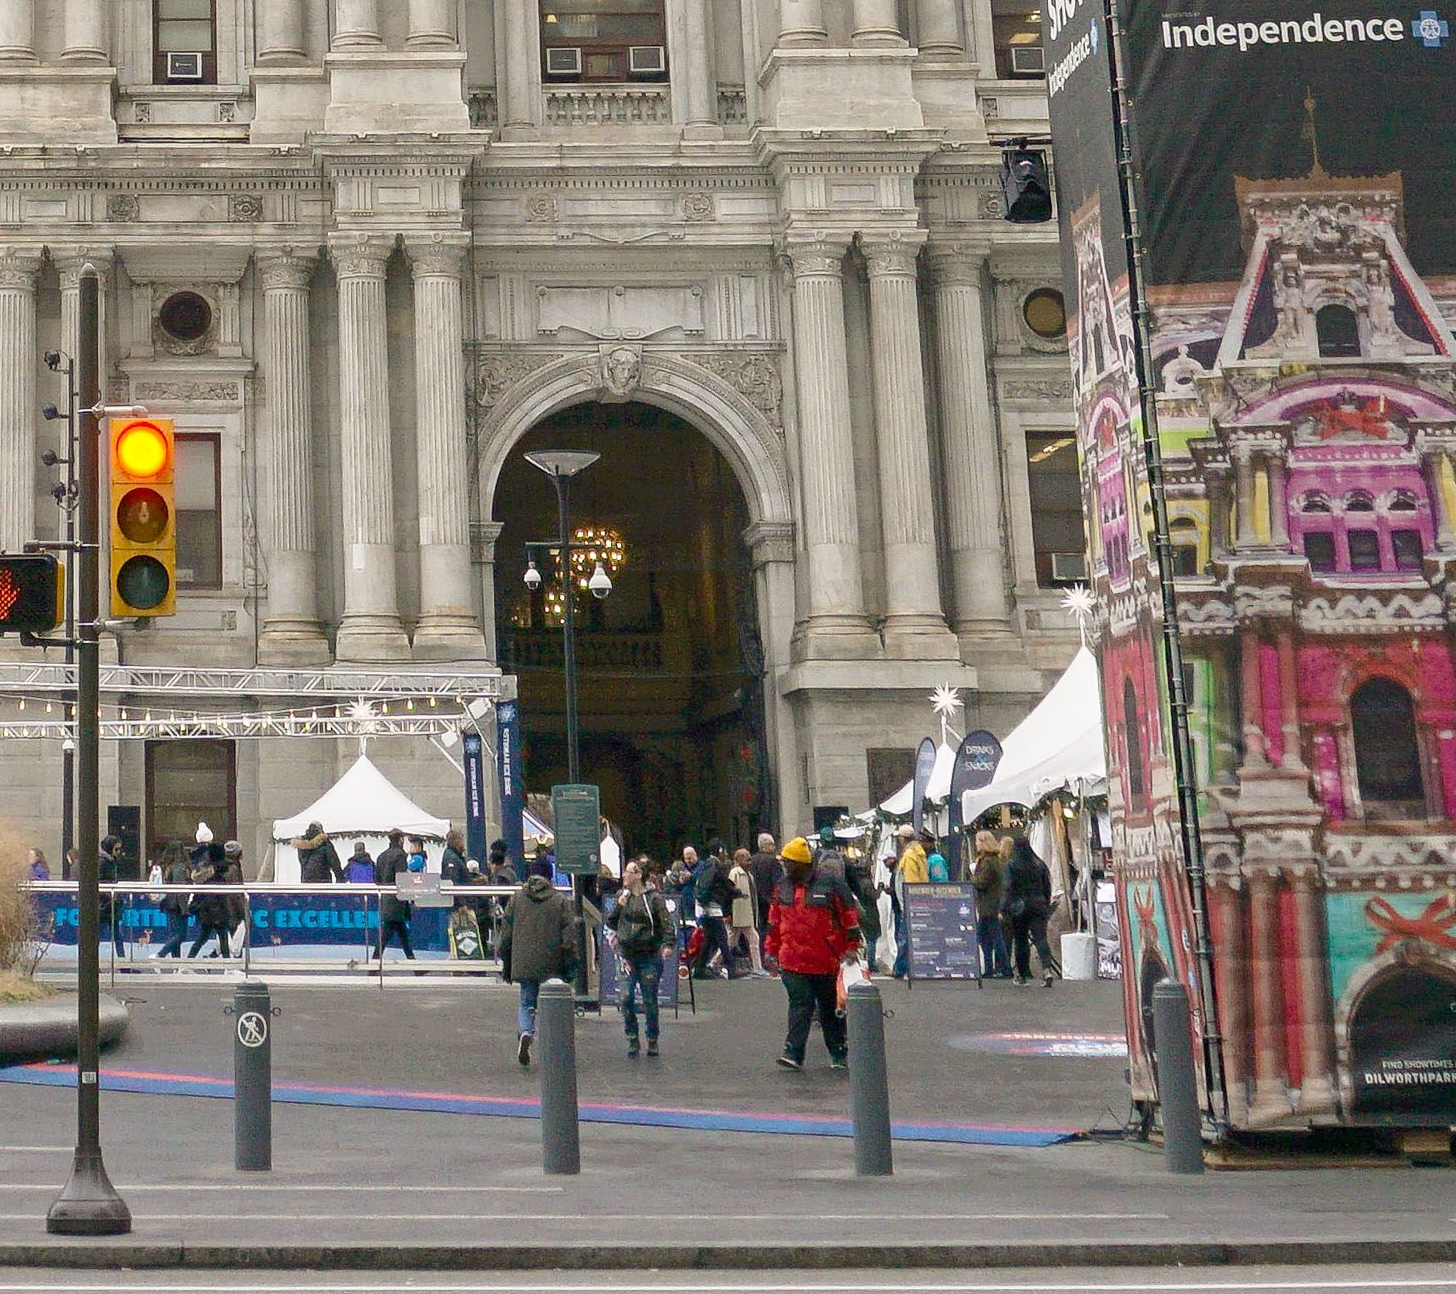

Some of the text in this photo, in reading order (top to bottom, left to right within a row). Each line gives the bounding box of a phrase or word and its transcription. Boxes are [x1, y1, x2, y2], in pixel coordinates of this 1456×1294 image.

[1161, 13, 1404, 52] Independence
[1048, 31, 1090, 97] Independence
[965, 745, 994, 755] DRINKS
[1382, 1061, 1403, 1070] FIND
[1404, 1059, 1454, 1070] SHOWTIMES
